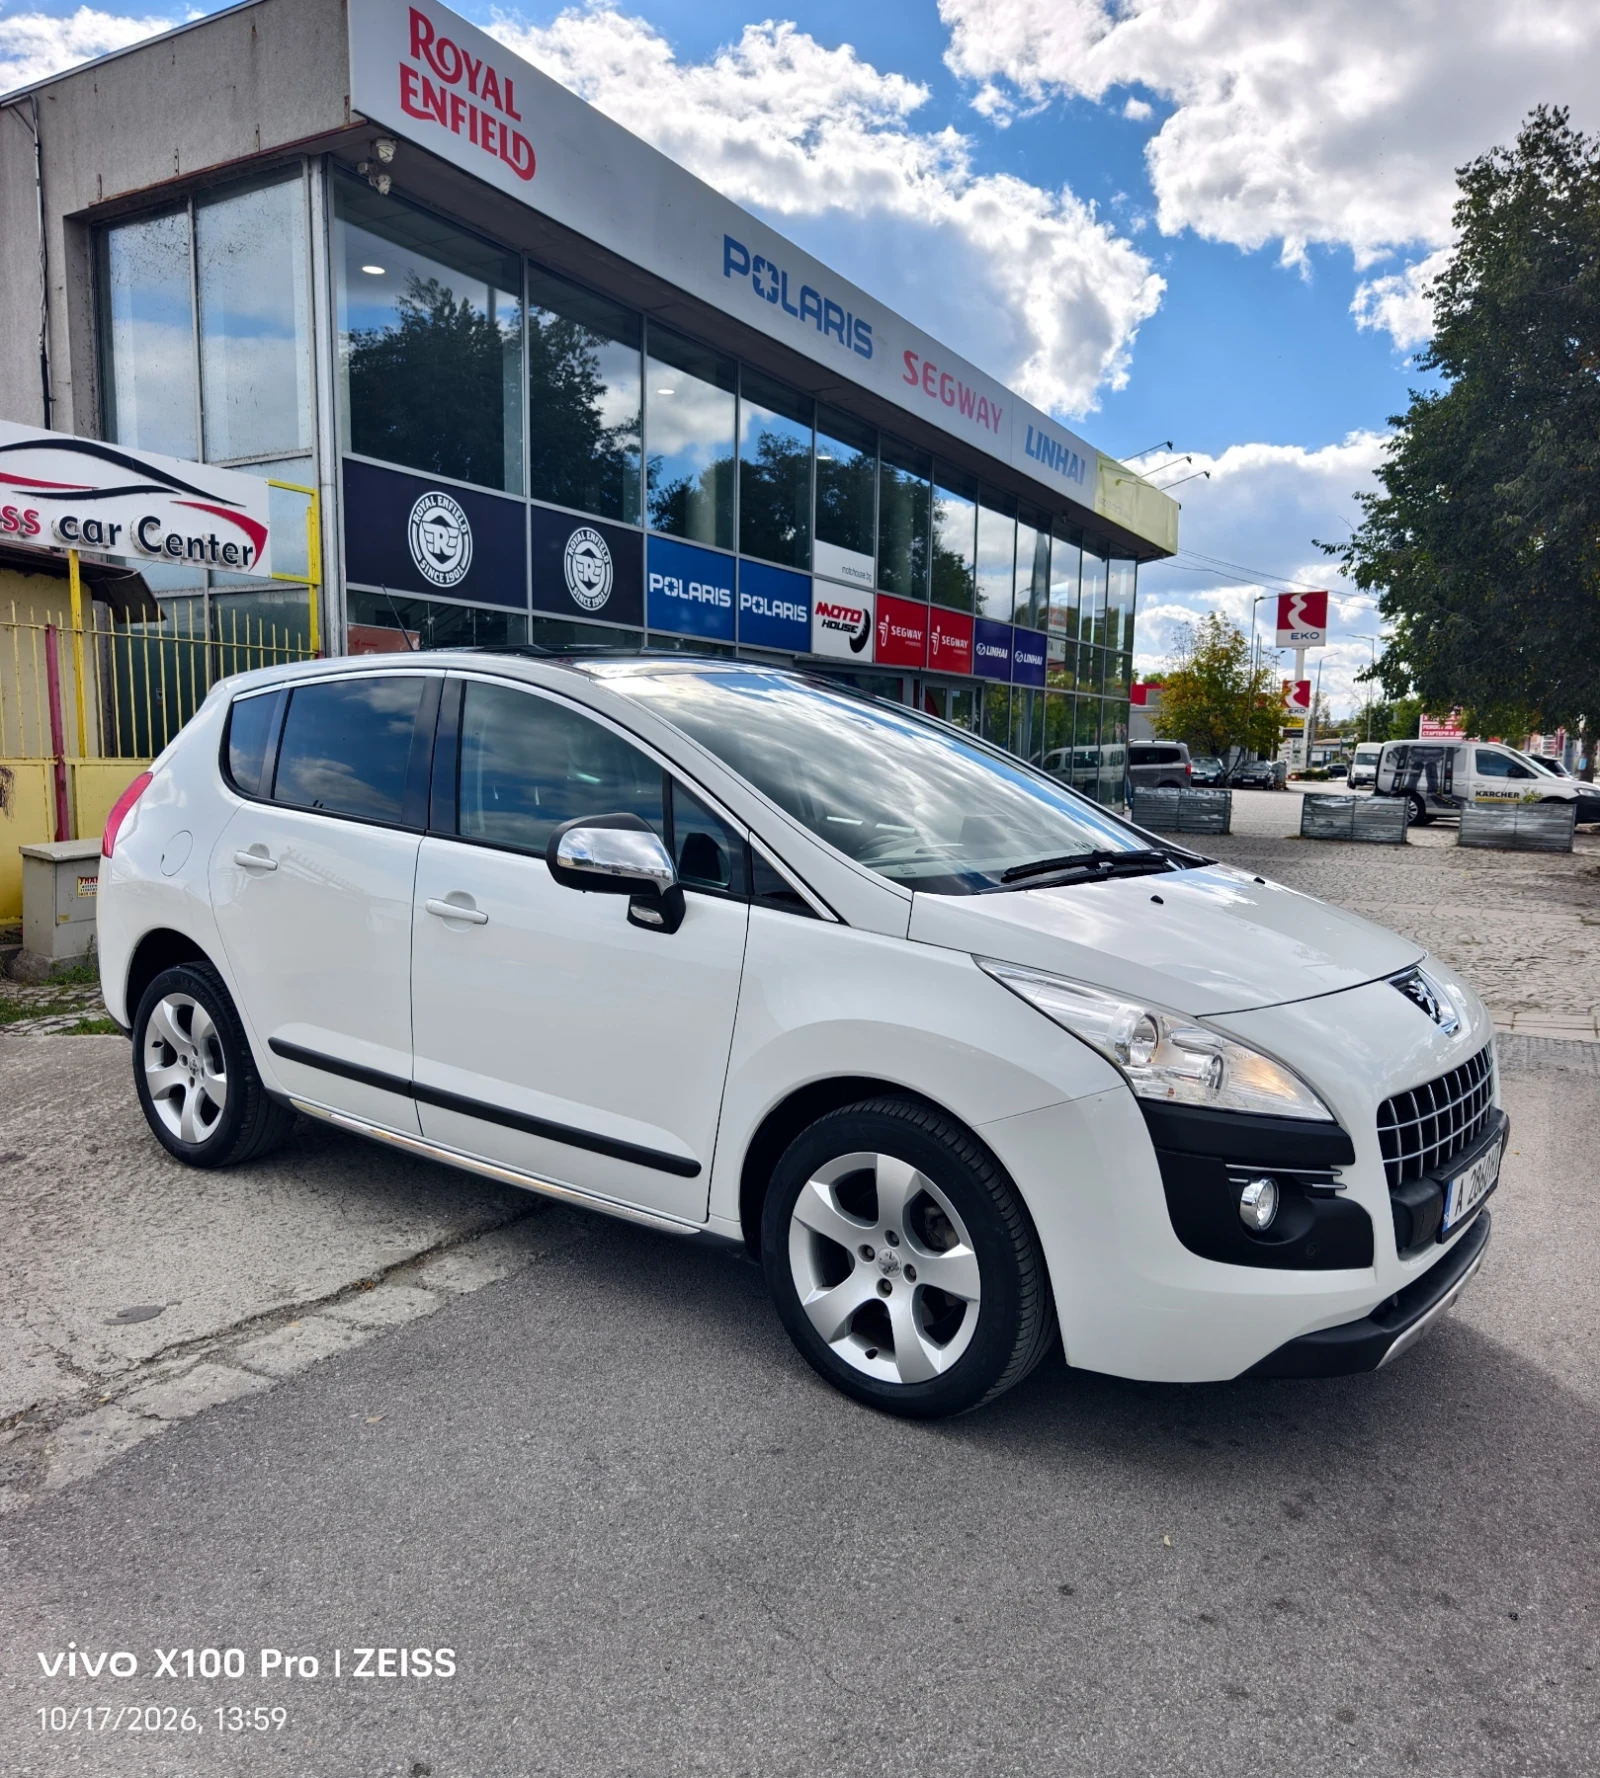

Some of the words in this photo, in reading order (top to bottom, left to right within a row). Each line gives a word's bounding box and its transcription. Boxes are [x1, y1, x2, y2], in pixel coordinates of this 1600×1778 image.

[409, 6, 521, 122] ROYAL
[399, 62, 536, 181] ENFIELD
[724, 234, 872, 360] POLARIS
[903, 350, 1003, 435] SEGWAY
[1025, 425, 1085, 486] LINHAI
[413, 496, 436, 524] ROYAL
[437, 496, 468, 533] ENFIELD
[58, 515, 122, 546] car
[137, 515, 254, 567] Center
[568, 531, 586, 556] ROYAL
[586, 531, 609, 563] ENFIELD
[420, 559, 444, 583] SINCE
[445, 565, 465, 583] 1901
[841, 564, 872, 583] motohouse.bg
[572, 586, 591, 607] SINCE
[592, 591, 606, 607] 1901
[649, 573, 731, 607] POLARIS
[740, 592, 807, 623] POLARIS
[815, 601, 862, 623] MOTO
[821, 619, 859, 634] HOUSE
[891, 625, 922, 641] SEGWAY
[941, 635, 969, 649] SEGWAY
[1290, 631, 1320, 641] EKO
[985, 645, 1008, 659] LINHAI
[1023, 653, 1043, 666] LINHAI
[1455, 1178, 1464, 1217] A
